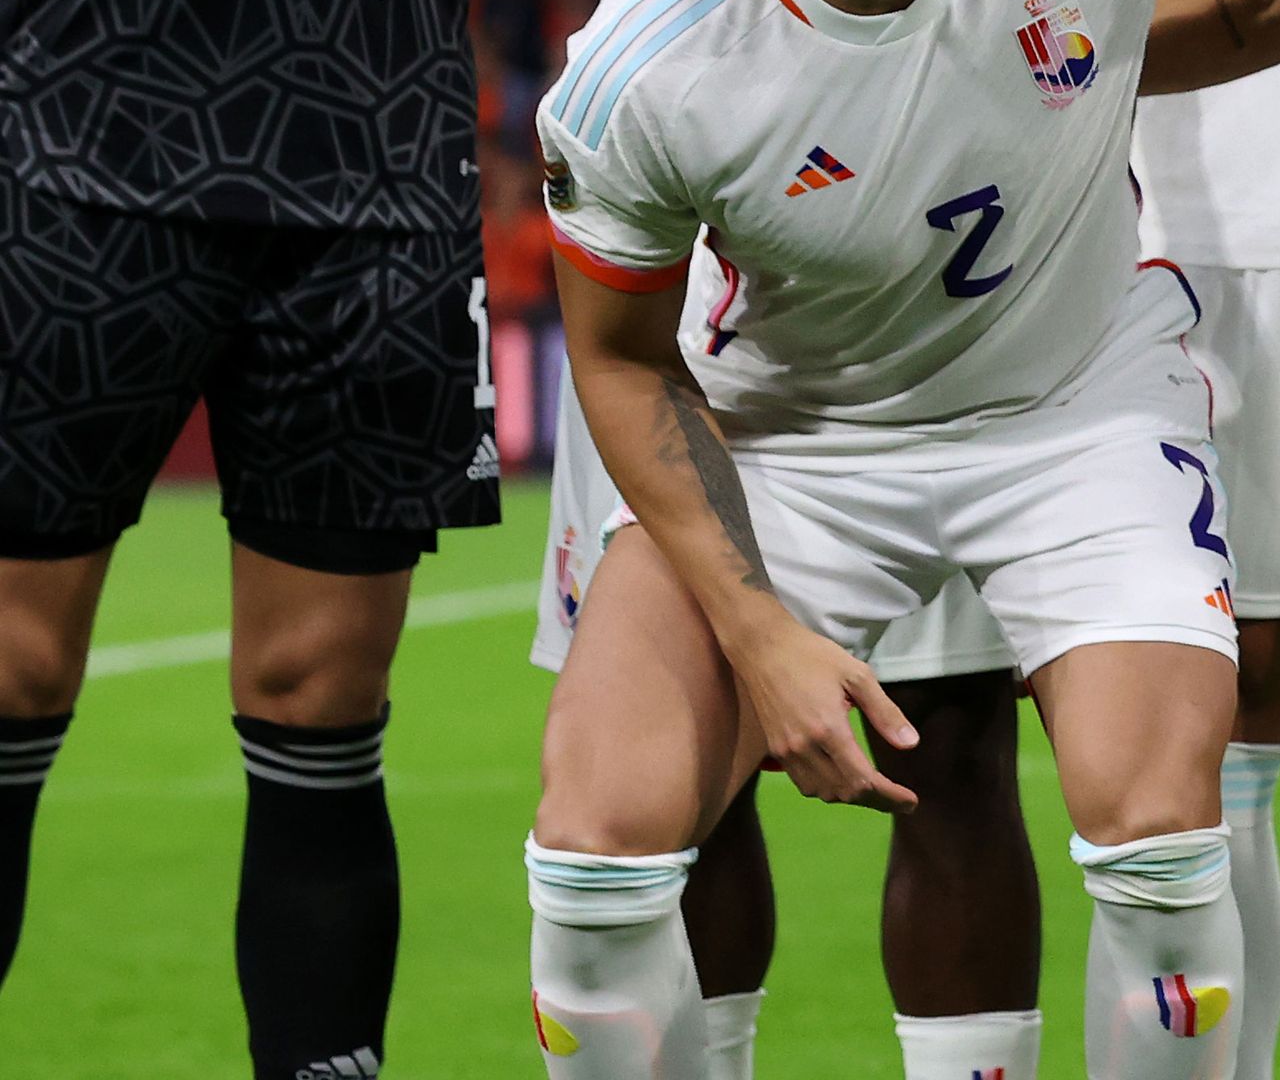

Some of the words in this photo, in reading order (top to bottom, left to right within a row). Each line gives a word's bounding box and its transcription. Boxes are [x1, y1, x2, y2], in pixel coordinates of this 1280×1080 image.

[926, 184, 1013, 298] 2
[468, 277, 496, 409] 1
[1160, 442, 1231, 567] 2
